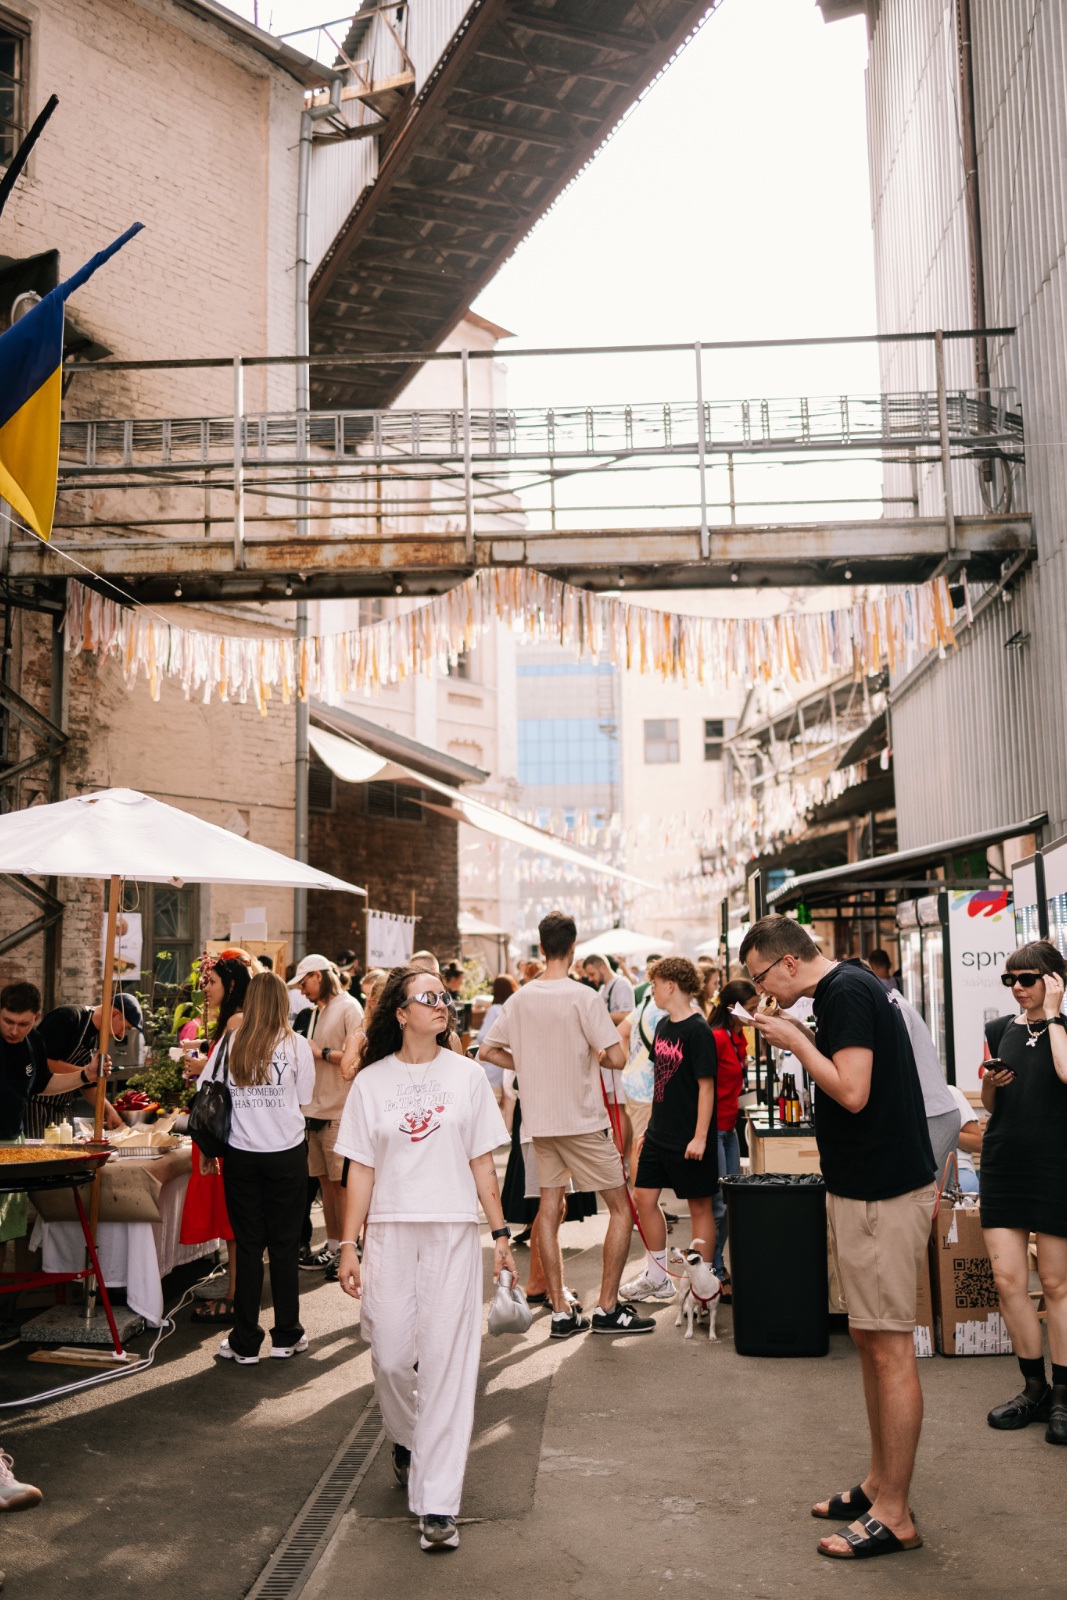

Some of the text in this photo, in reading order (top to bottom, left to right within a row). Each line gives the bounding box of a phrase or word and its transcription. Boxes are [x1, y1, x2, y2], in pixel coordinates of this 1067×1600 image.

[962, 952, 1009, 971] spr
[230, 1088, 245, 1097] BUT
[235, 1099, 251, 1109] HAS
[252, 1099, 263, 1108] TO
[265, 1099, 276, 1108] DO
[423, 1092, 454, 1106] PAIR
